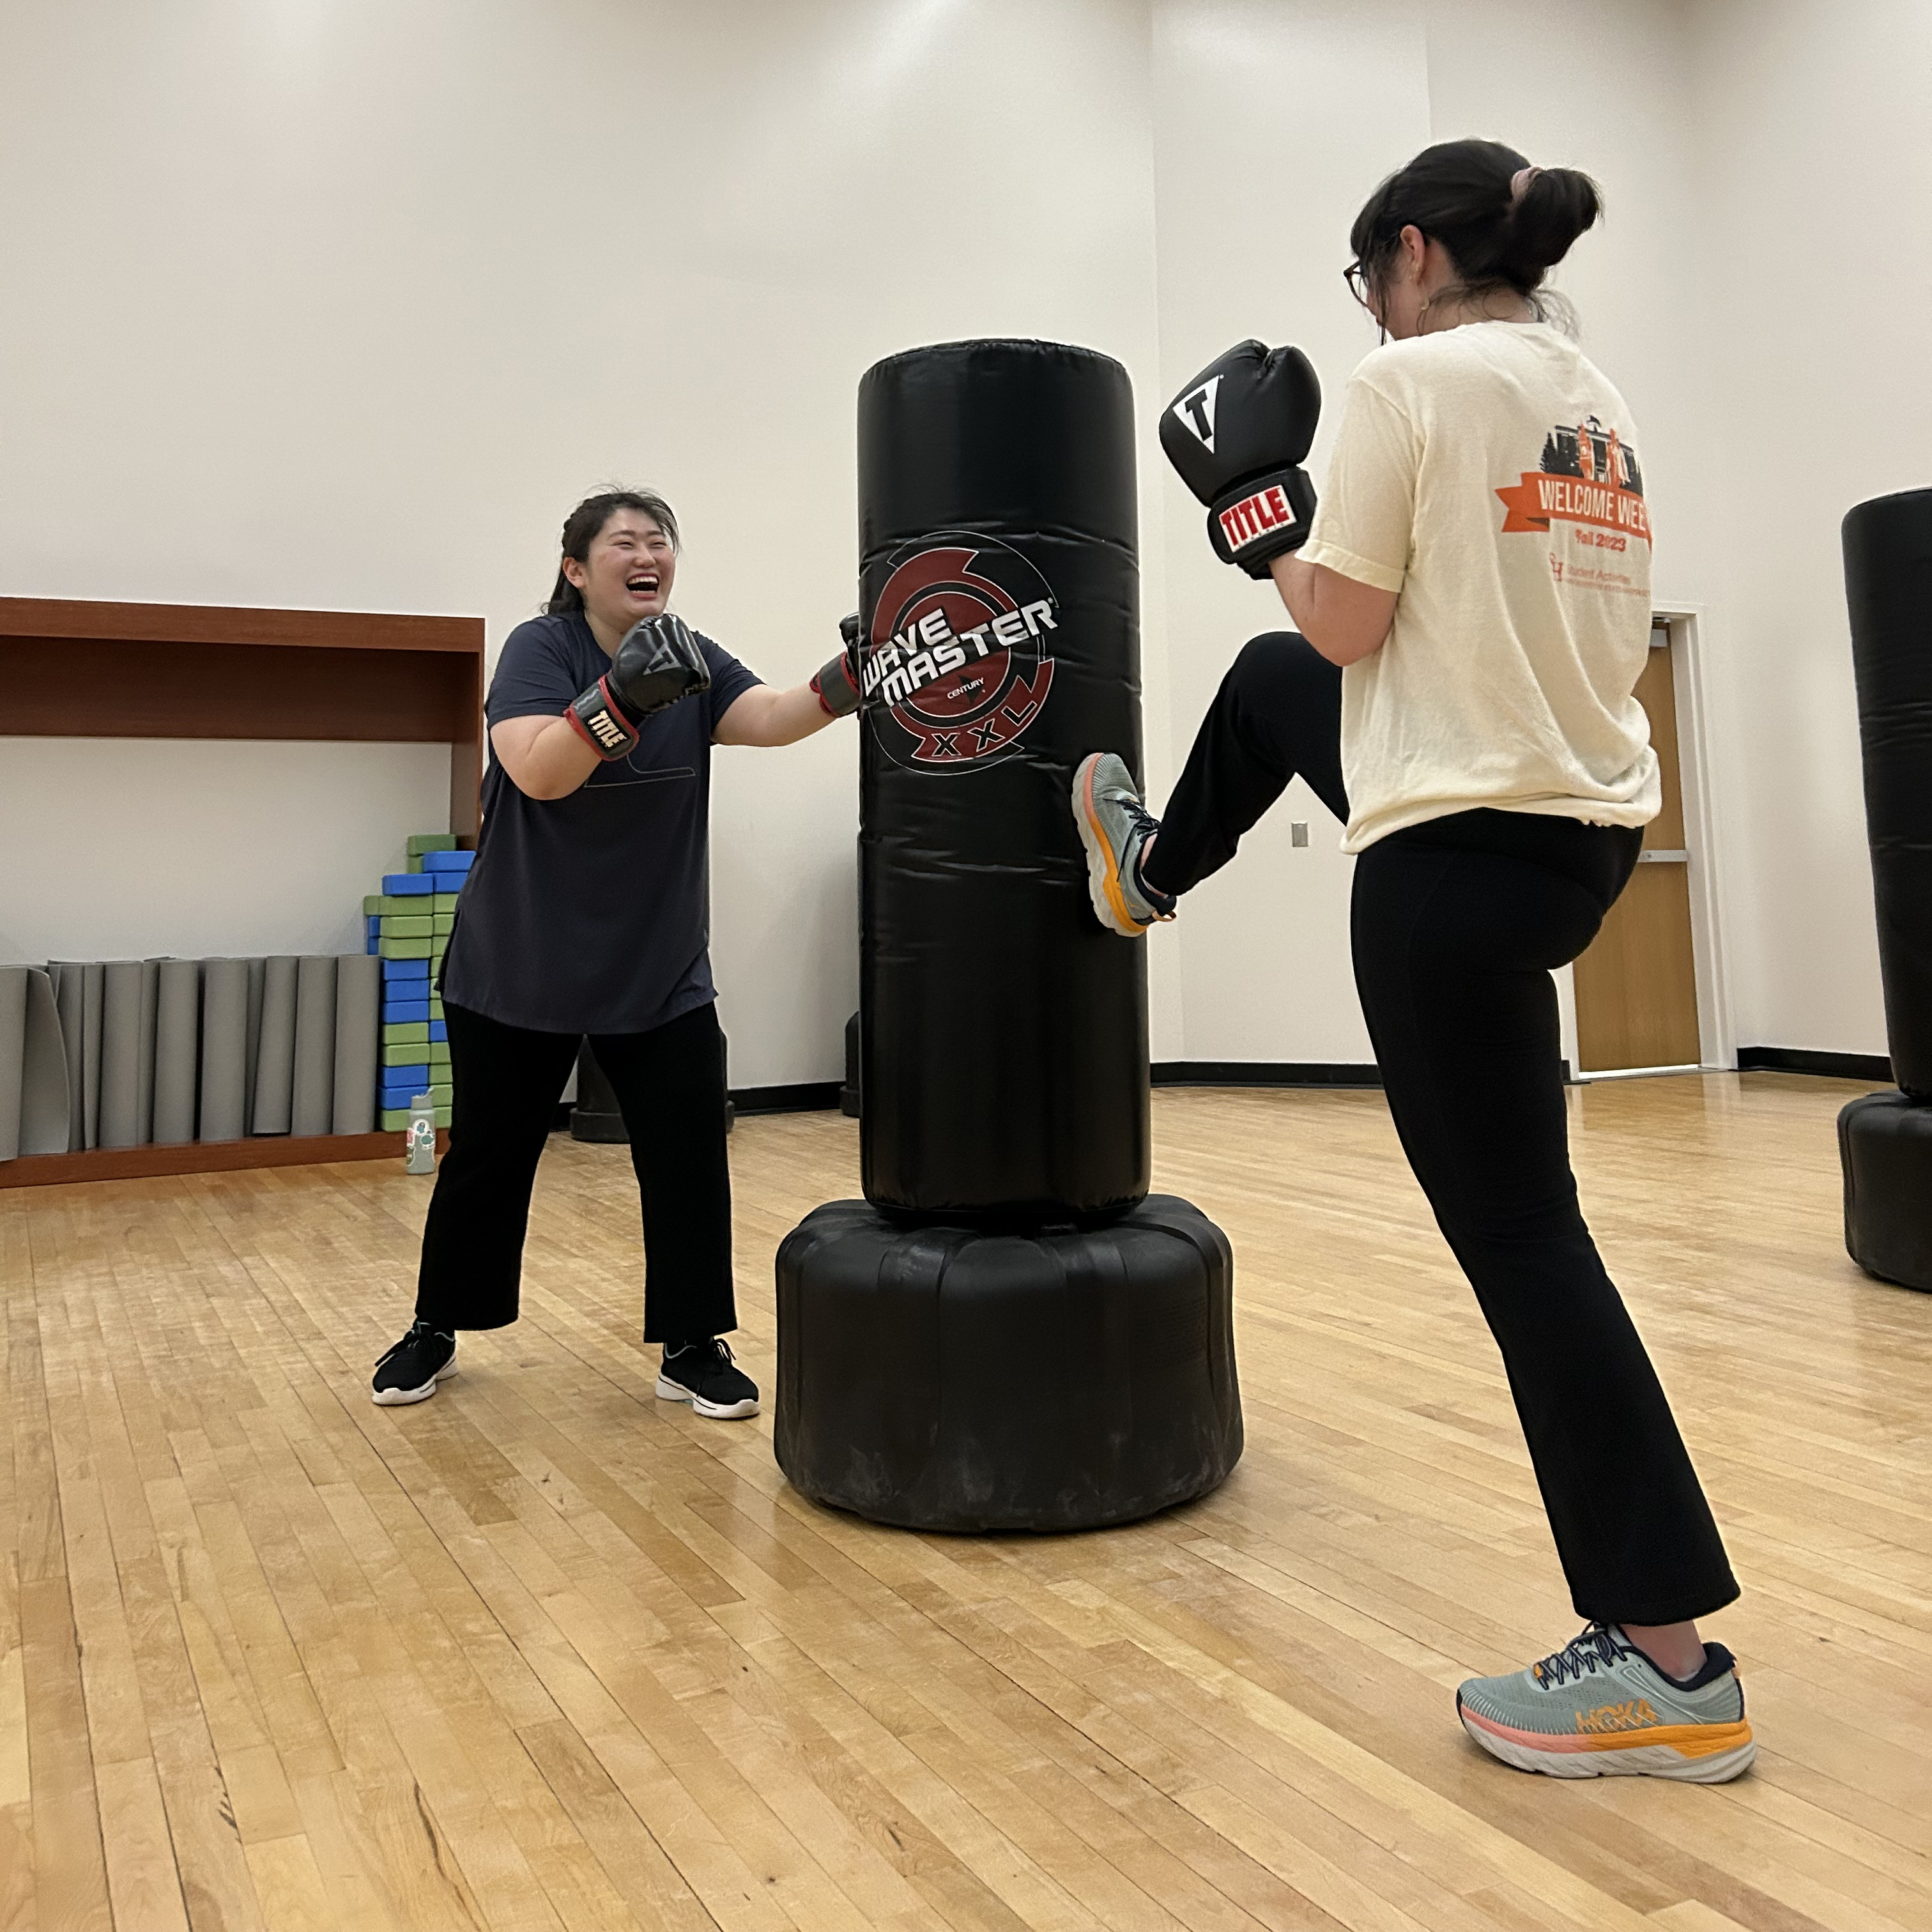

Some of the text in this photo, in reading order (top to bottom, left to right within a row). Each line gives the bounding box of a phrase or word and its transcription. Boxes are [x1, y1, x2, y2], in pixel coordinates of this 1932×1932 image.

[1220, 487, 1290, 546] TITLE
[1537, 479, 1647, 532] WELCOME WEE
[1575, 528, 1627, 553] Fall 2023
[862, 608, 952, 697] WAVE
[881, 599, 1059, 707] MASTER
[947, 677, 984, 700] CENTURY
[588, 709, 628, 748] TITLE
[931, 700, 1038, 757] XXL
[1575, 1699, 1657, 1735] HOKA
